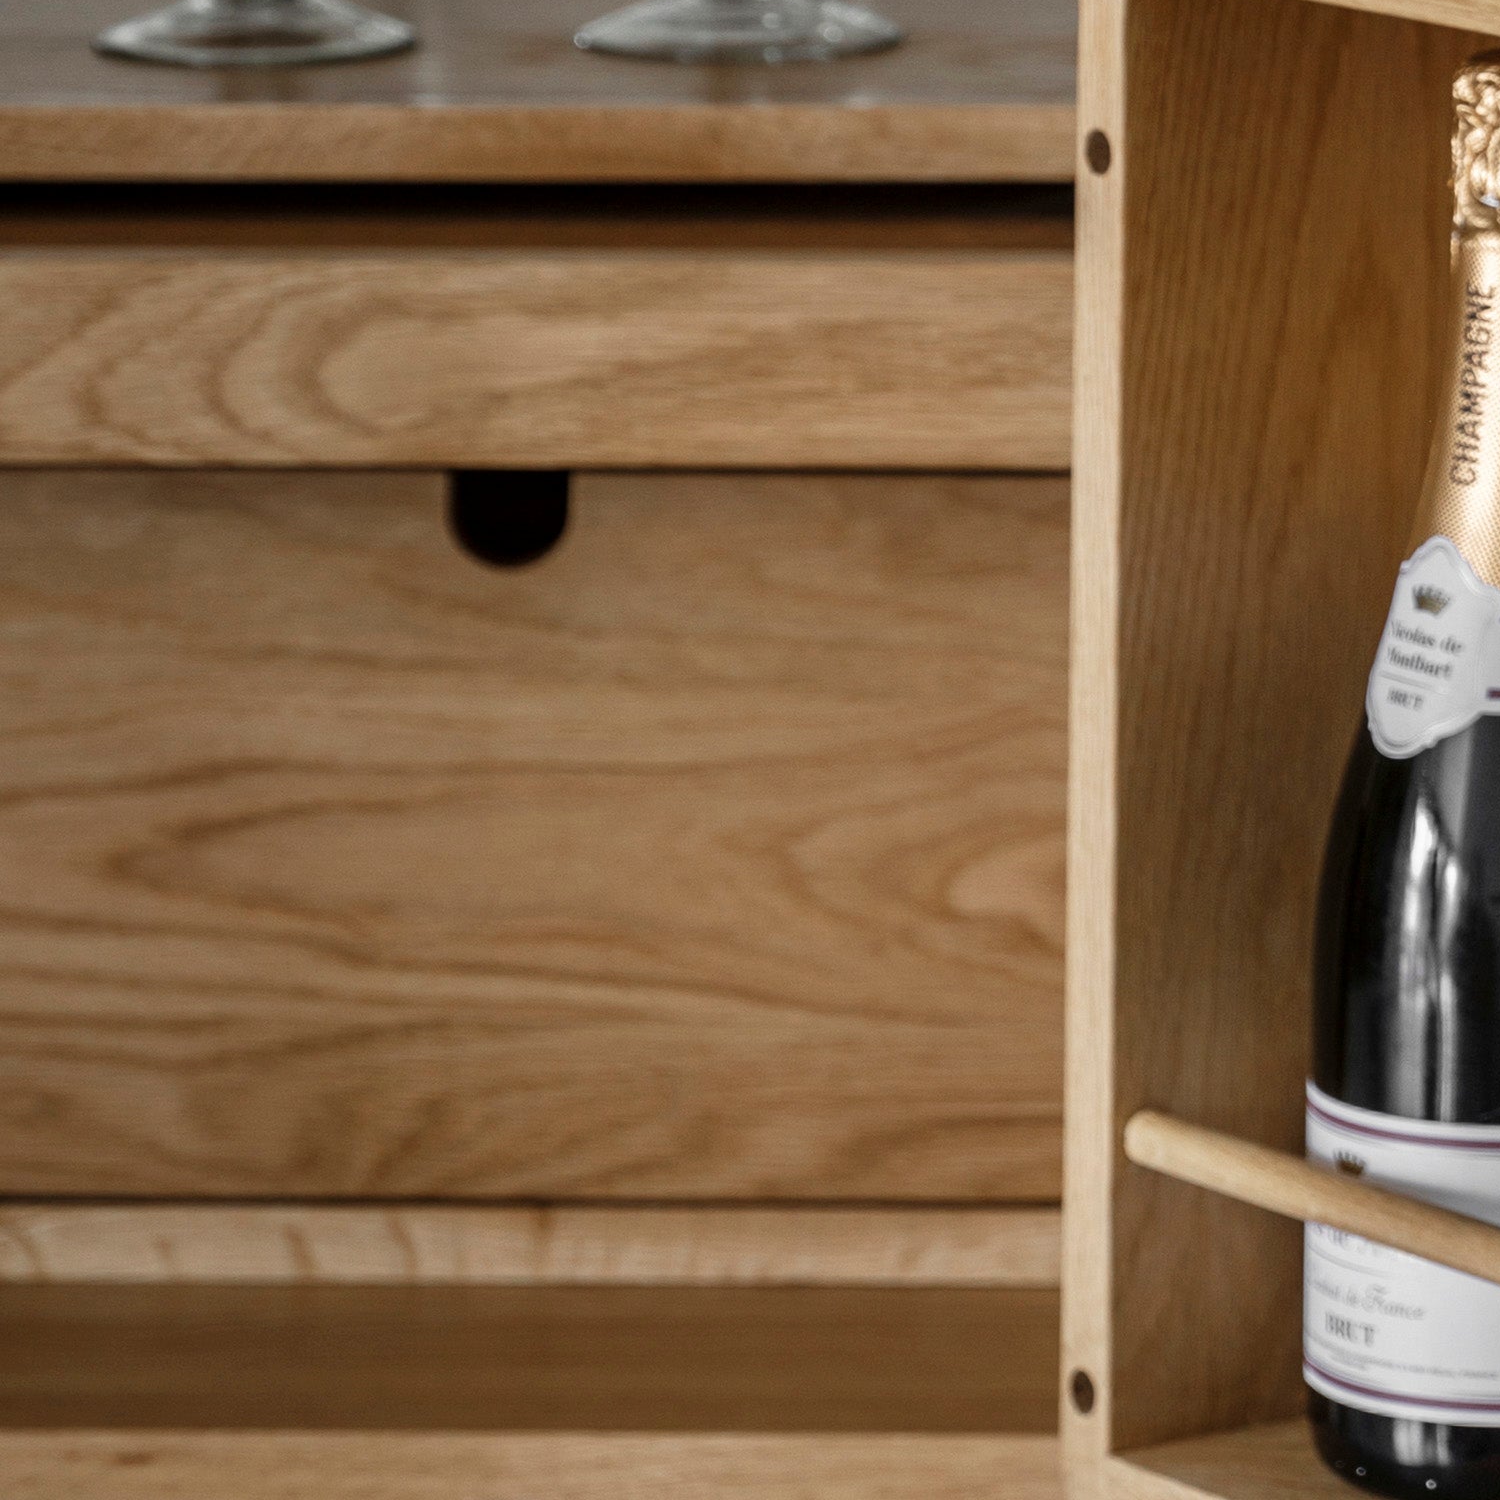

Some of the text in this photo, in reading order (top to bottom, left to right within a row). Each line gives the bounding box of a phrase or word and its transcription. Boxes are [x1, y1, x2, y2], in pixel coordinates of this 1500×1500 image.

[1450, 281, 1496, 486] CHAMPAGNE
[1440, 636, 1464, 655] de
[1325, 1311, 1375, 1347] BRUT
